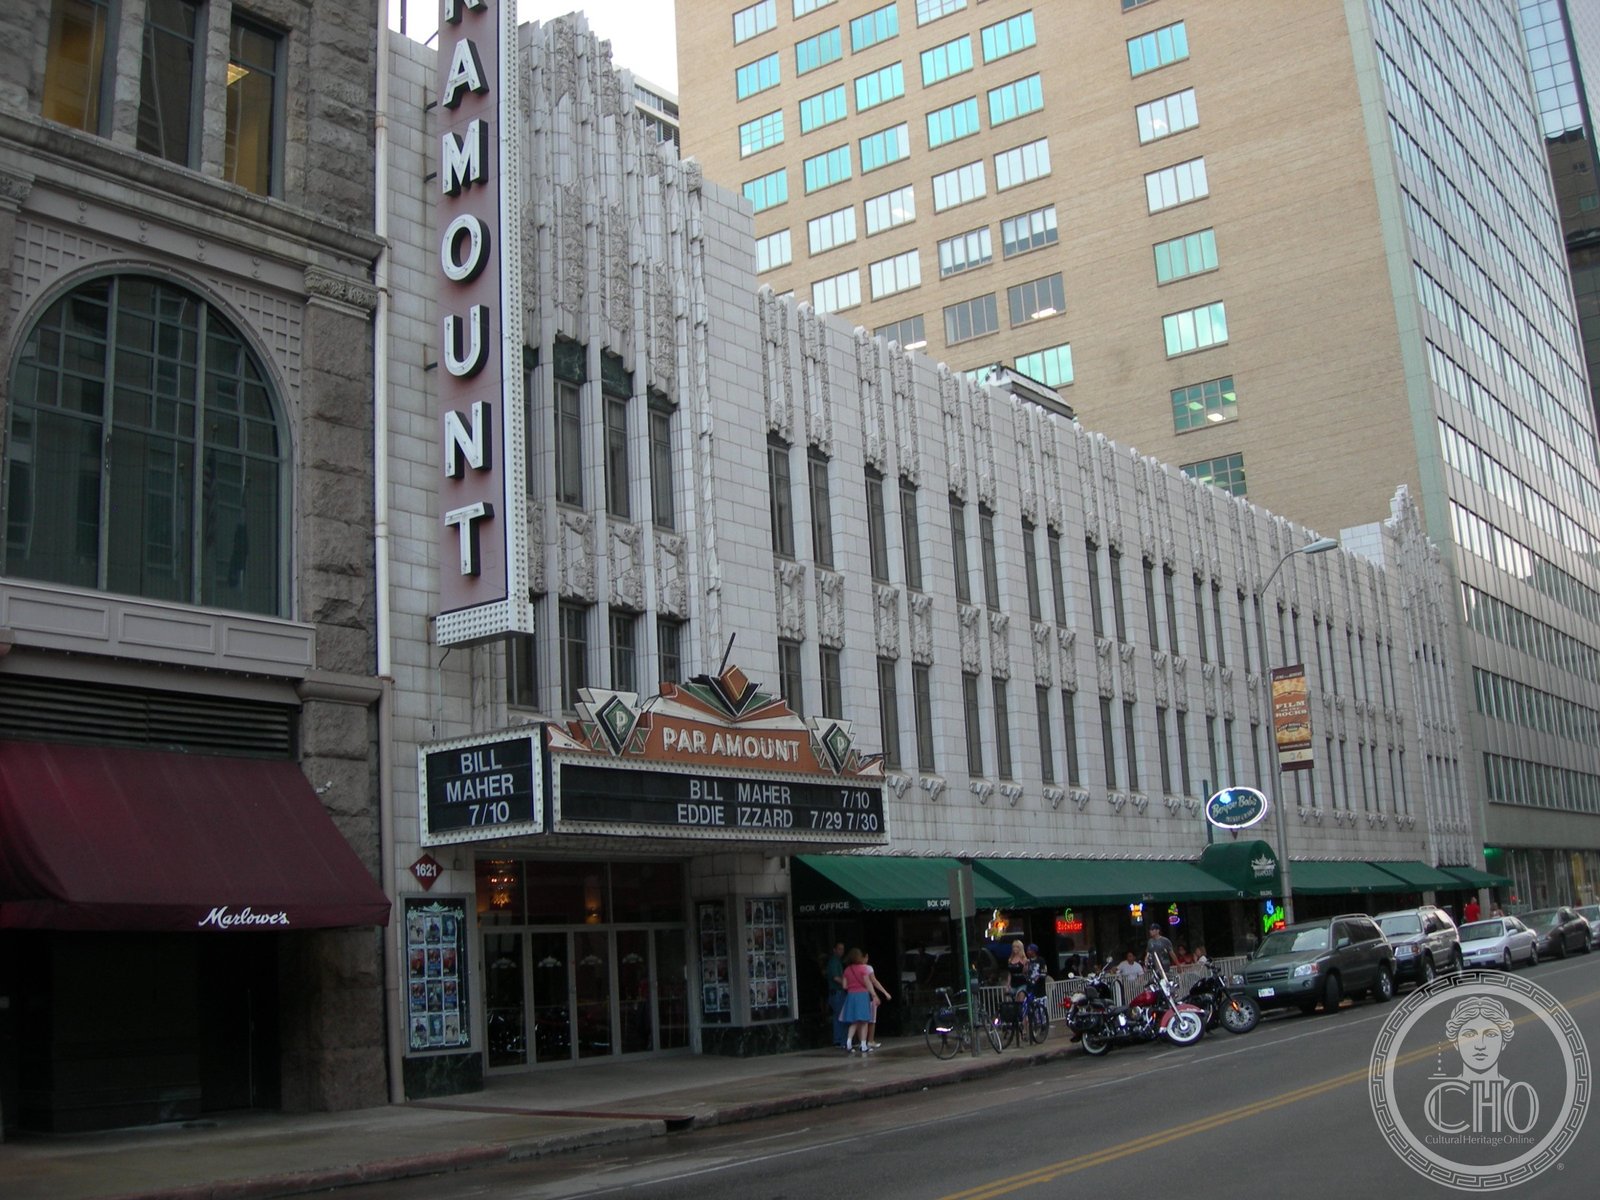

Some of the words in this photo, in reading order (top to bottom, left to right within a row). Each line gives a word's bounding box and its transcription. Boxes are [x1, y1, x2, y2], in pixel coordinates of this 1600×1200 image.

[615, 709, 628, 735] P
[460, 749, 503, 775] BILL
[446, 773, 514, 803] MAHER
[738, 783, 791, 804] MAHER
[841, 790, 870, 809] 7/10
[468, 801, 510, 826] 7/10
[677, 803, 725, 825] EDDIE
[737, 807, 793, 828] IZZARD
[810, 811, 842, 830] 7/29
[846, 812, 878, 831] 7/30
[415, 862, 438, 878] 1621
[799, 904, 815, 913] BOX
[819, 901, 850, 911] OFFICE
[927, 899, 938, 908] BOX
[939, 899, 951, 908] OFF
[198, 905, 290, 929] Marlowe's
